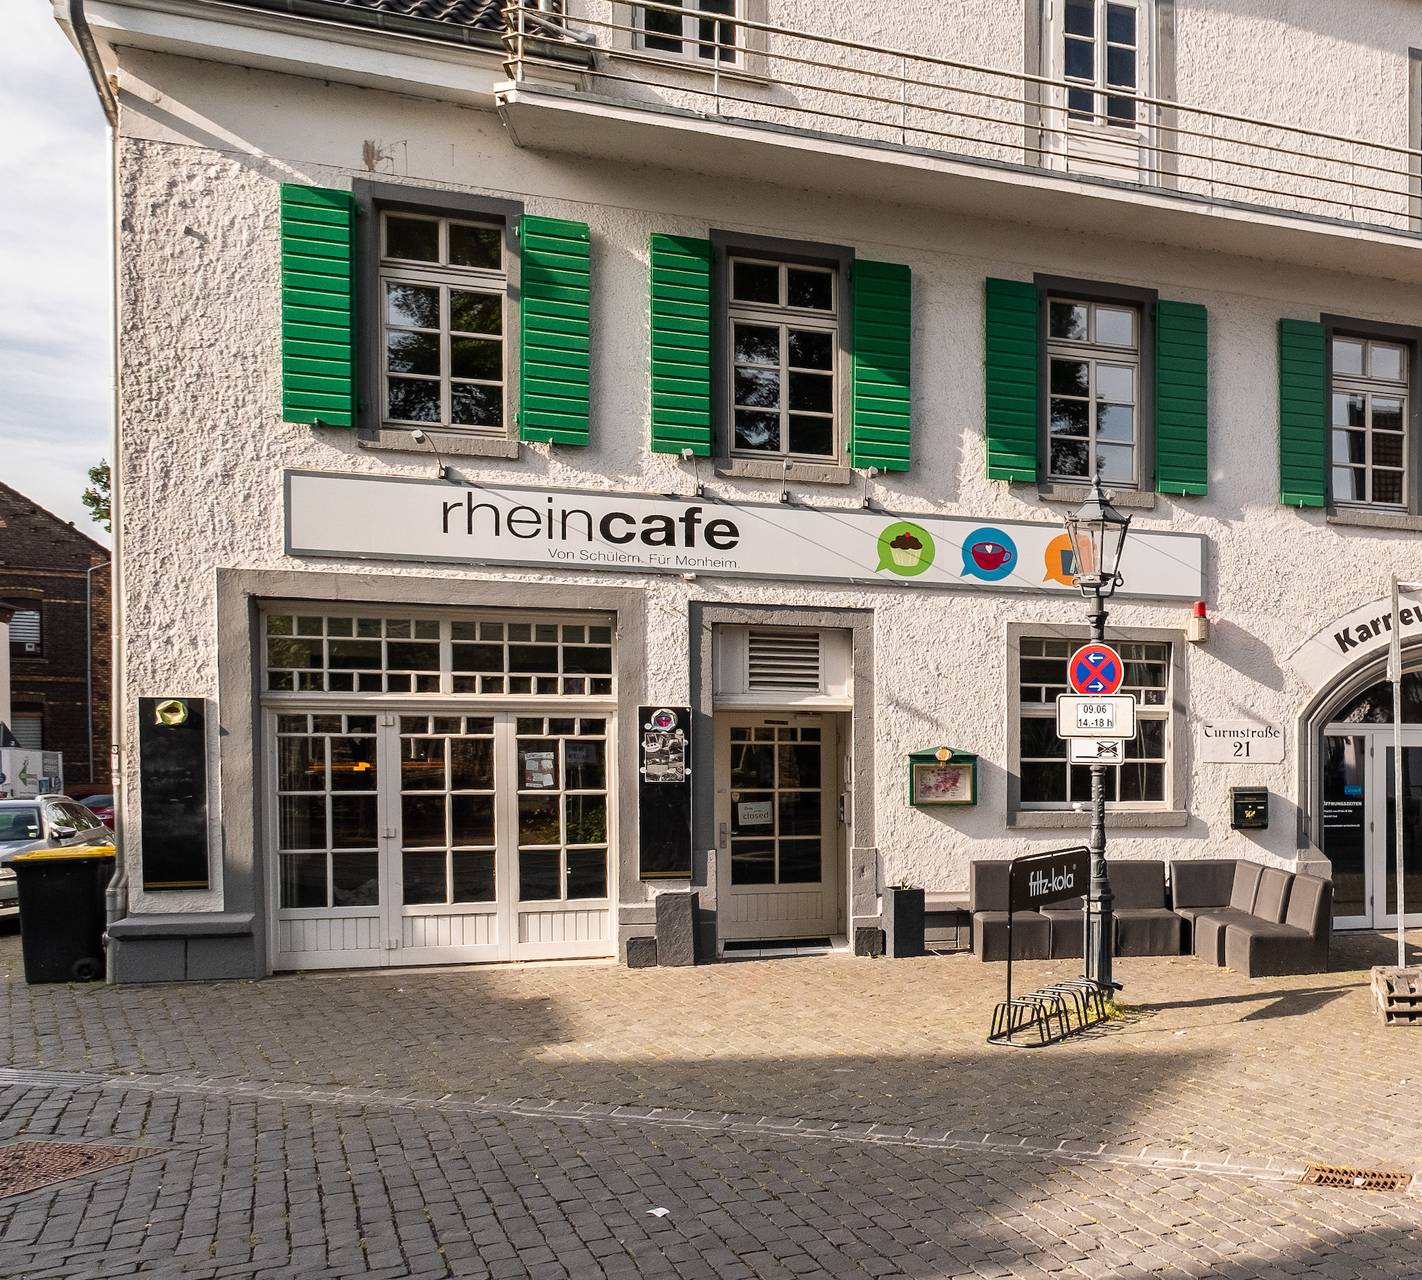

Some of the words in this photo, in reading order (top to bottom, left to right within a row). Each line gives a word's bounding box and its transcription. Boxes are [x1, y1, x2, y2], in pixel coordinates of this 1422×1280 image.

[441, 491, 740, 551] rheincafe
[547, 548, 575, 560] Von
[648, 553, 671, 566] Für
[675, 555, 741, 569] Monheim.
[1083, 704, 1107, 714] 09.06
[1106, 718, 1113, 728] h
[1203, 725, 1281, 739] Turmstraße
[1232, 741, 1251, 757] 21
[743, 811, 769, 820] closed
[1029, 866, 1074, 897] fritz-kola
